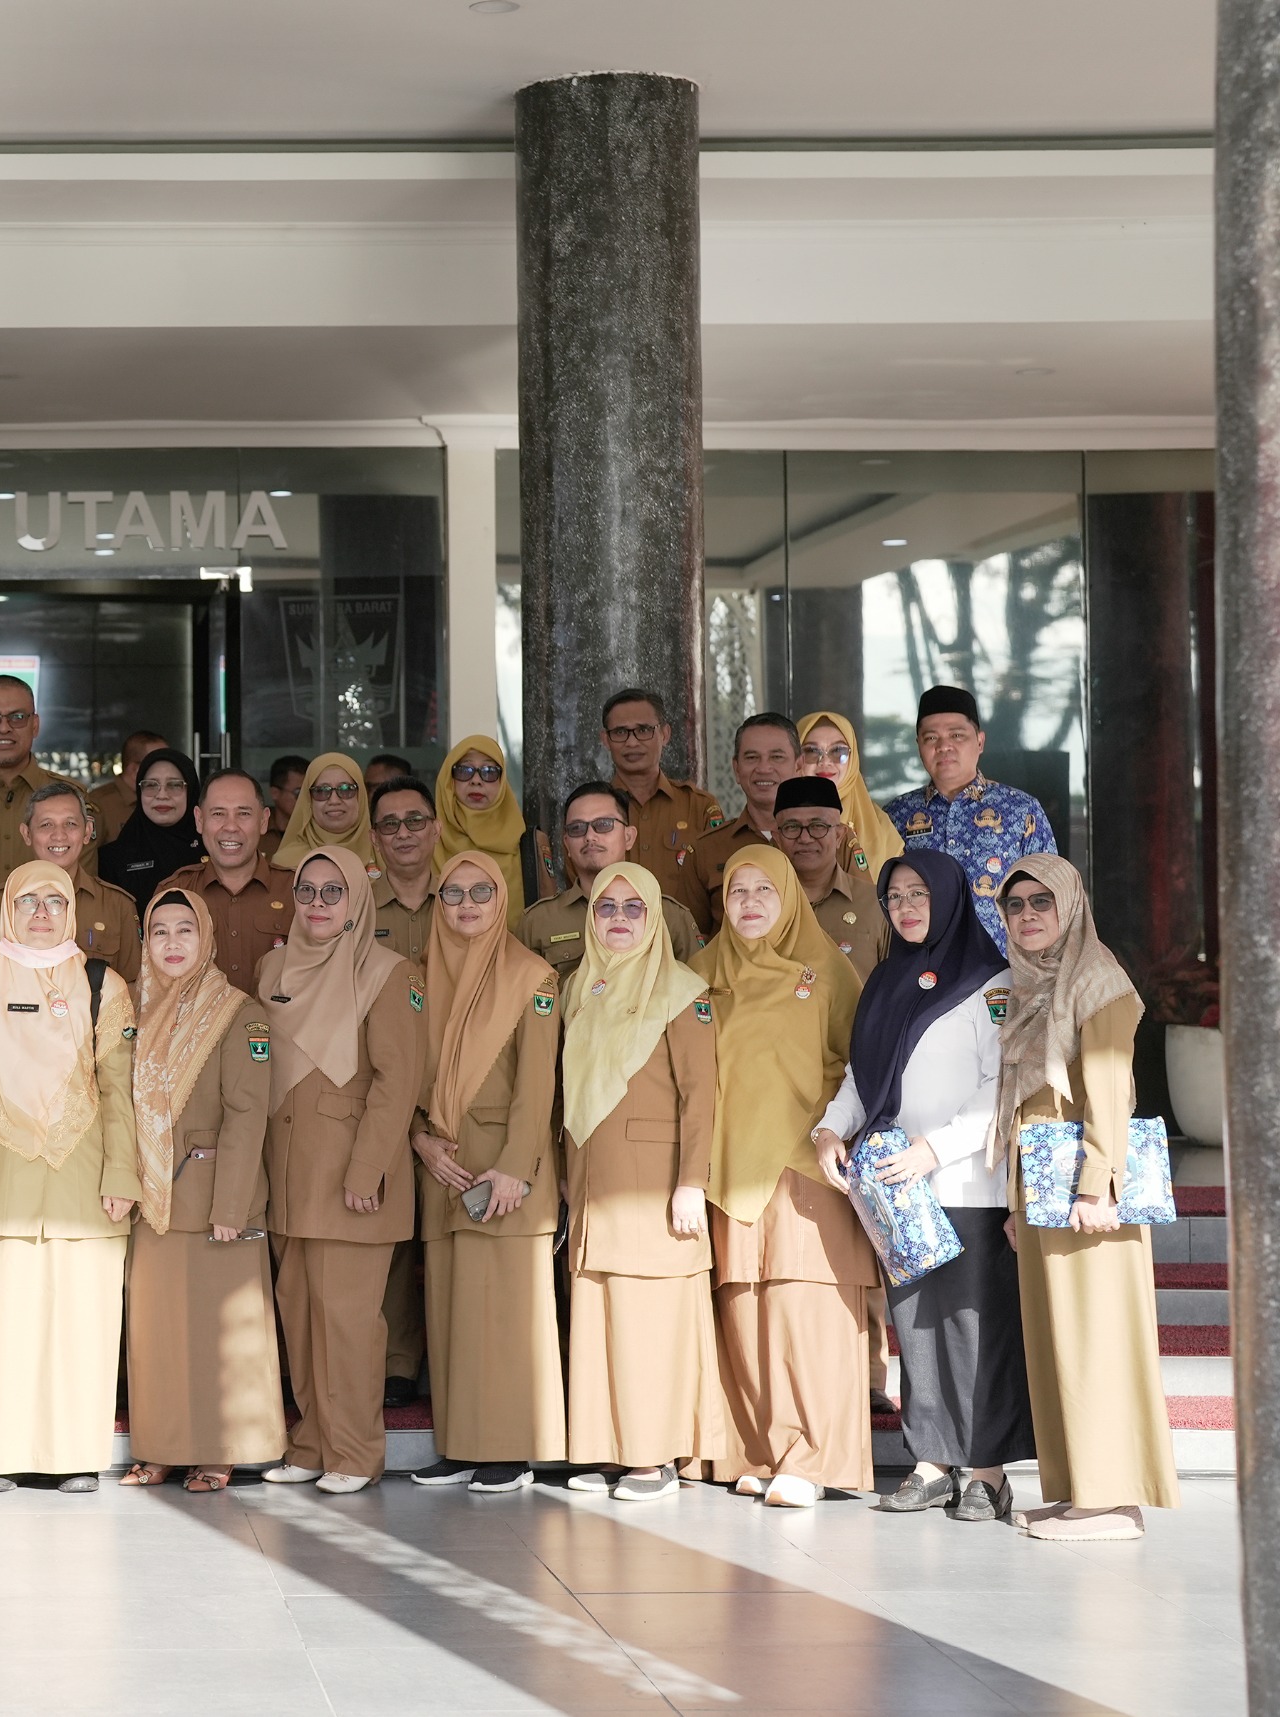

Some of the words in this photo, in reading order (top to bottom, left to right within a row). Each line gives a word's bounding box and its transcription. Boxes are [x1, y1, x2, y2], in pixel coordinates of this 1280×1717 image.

[14, 491, 289, 551] UTAMA
[287, 601, 354, 616] SUMERA
[354, 600, 393, 615] BARAT
